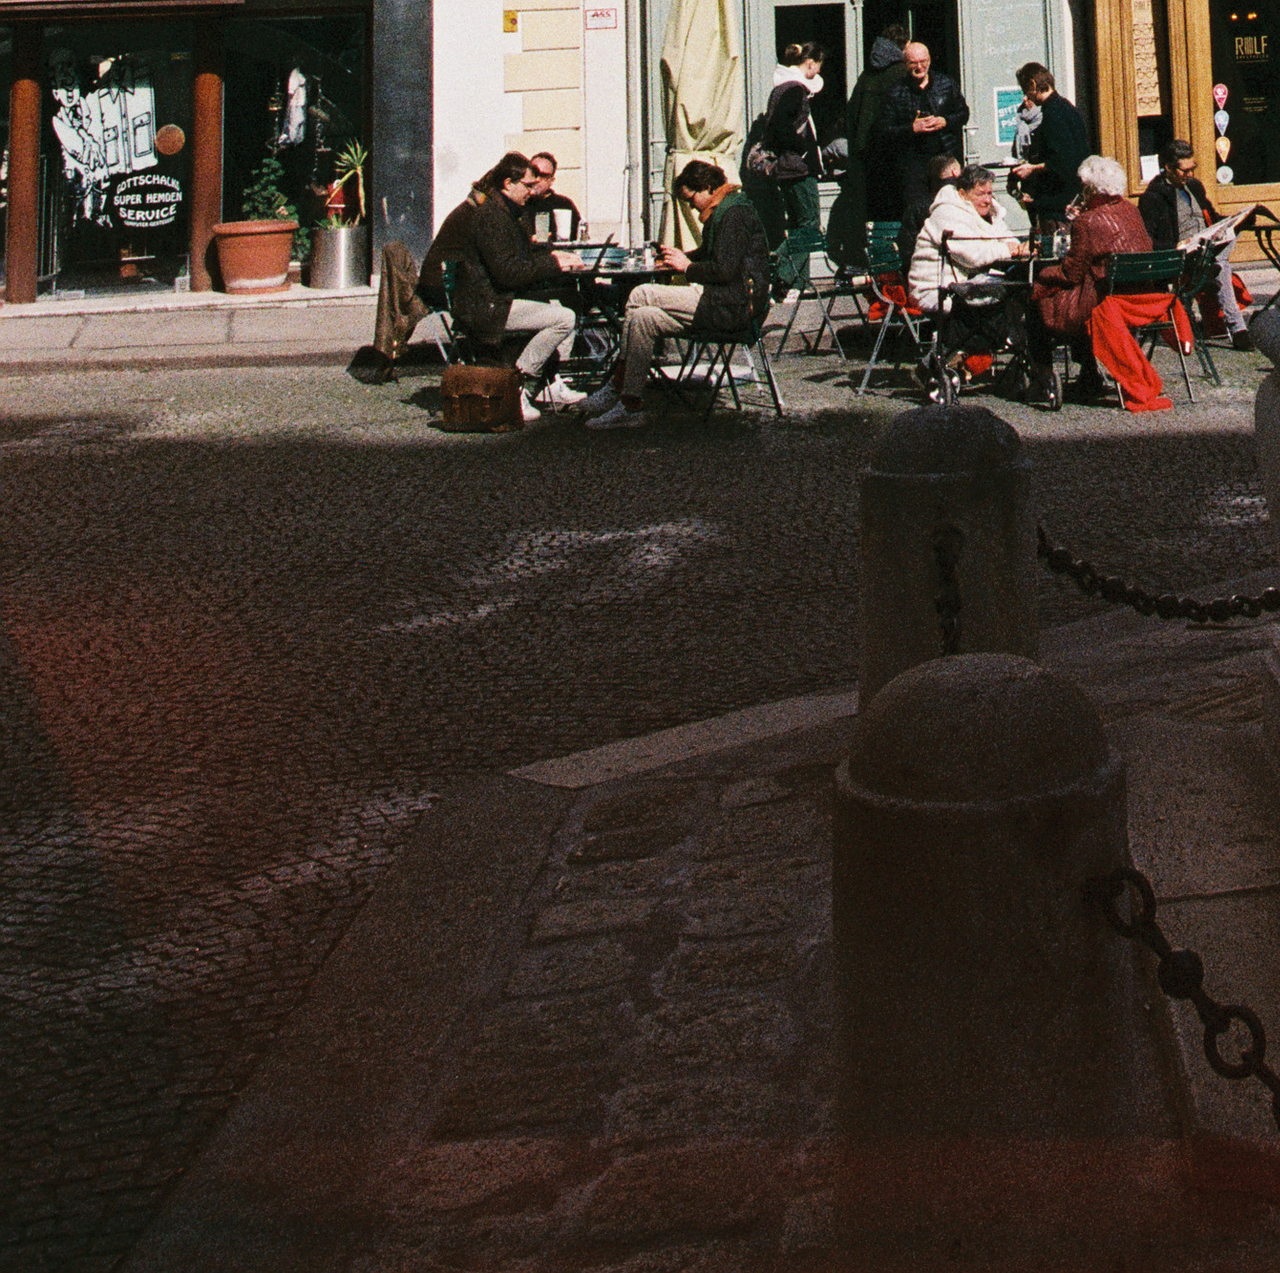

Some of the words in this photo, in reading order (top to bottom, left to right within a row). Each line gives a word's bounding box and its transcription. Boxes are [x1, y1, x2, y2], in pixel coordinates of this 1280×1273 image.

[113, 193, 142, 206] SUPER
[145, 191, 183, 204] HEMDEN
[118, 203, 177, 221] SERVICE
